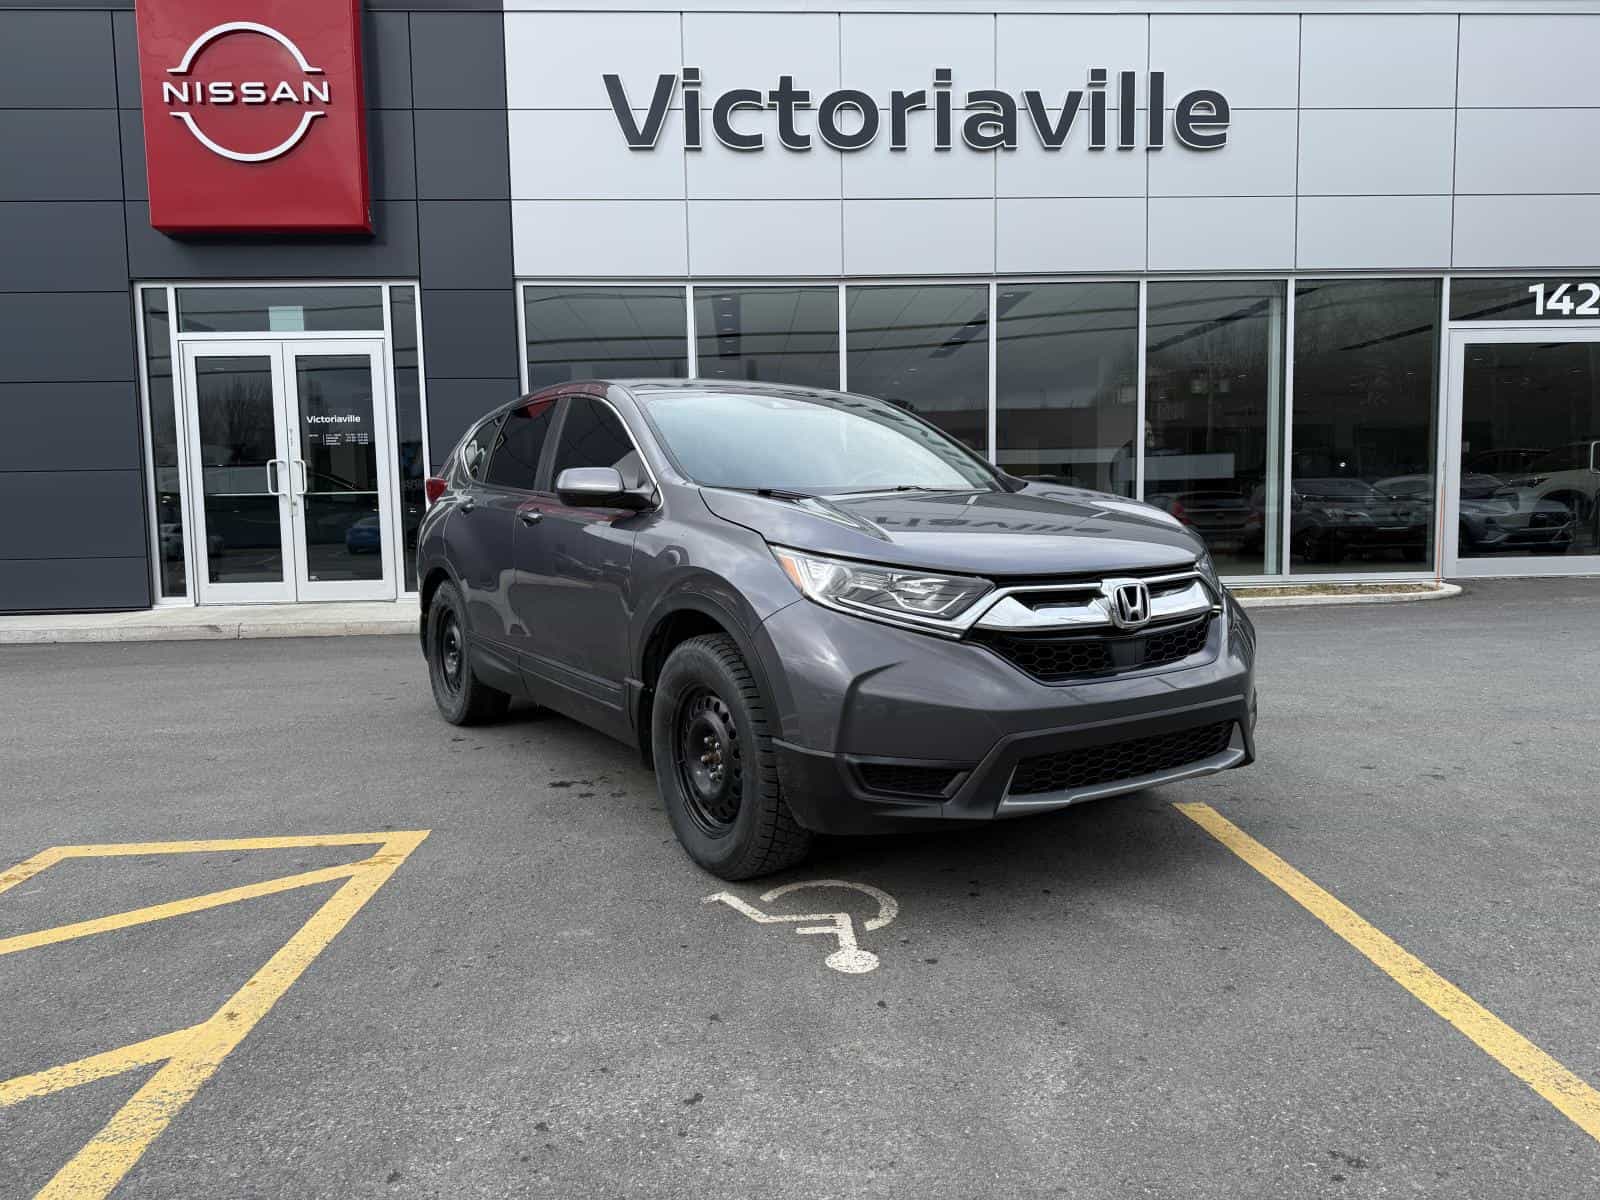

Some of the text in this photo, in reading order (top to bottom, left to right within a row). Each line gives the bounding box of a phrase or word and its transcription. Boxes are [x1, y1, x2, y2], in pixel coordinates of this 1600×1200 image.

[162, 80, 330, 104] NISSAN
[602, 67, 1232, 152] Victoriaville
[1528, 282, 1600, 316] 142
[305, 414, 361, 424] Victoriaville
